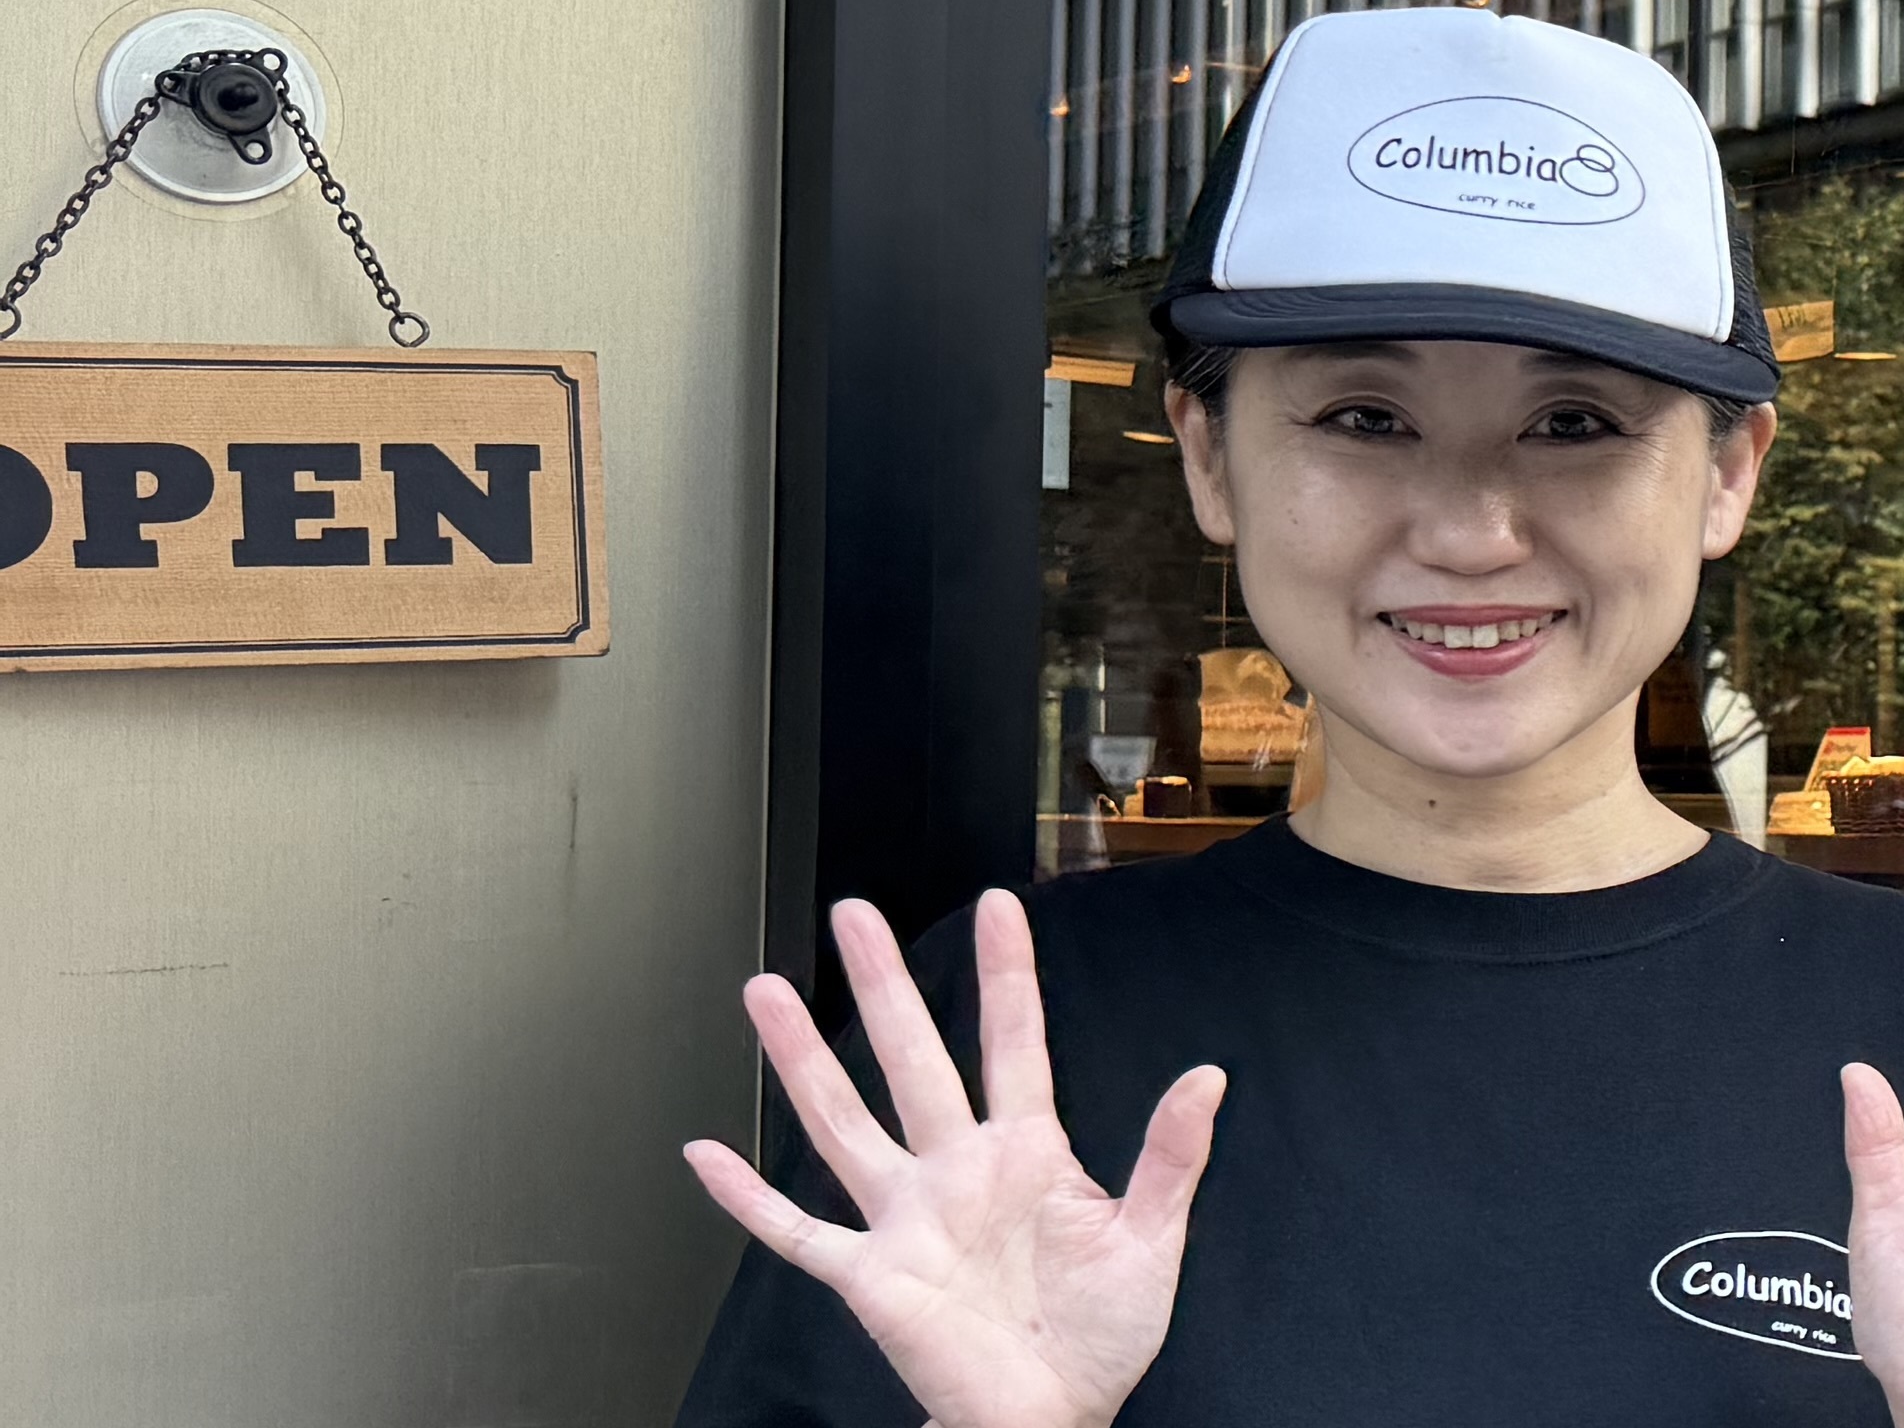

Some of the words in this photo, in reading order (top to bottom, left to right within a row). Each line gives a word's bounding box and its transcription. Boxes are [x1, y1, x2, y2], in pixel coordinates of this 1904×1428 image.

[1375, 135, 1558, 183] Columbia
[1458, 192, 1498, 208] curry
[1507, 198, 1536, 210] rice
[1681, 1260, 1854, 1321] Columbia
[1770, 1320, 1808, 1340] curry
[1812, 1328, 1837, 1345] rice
